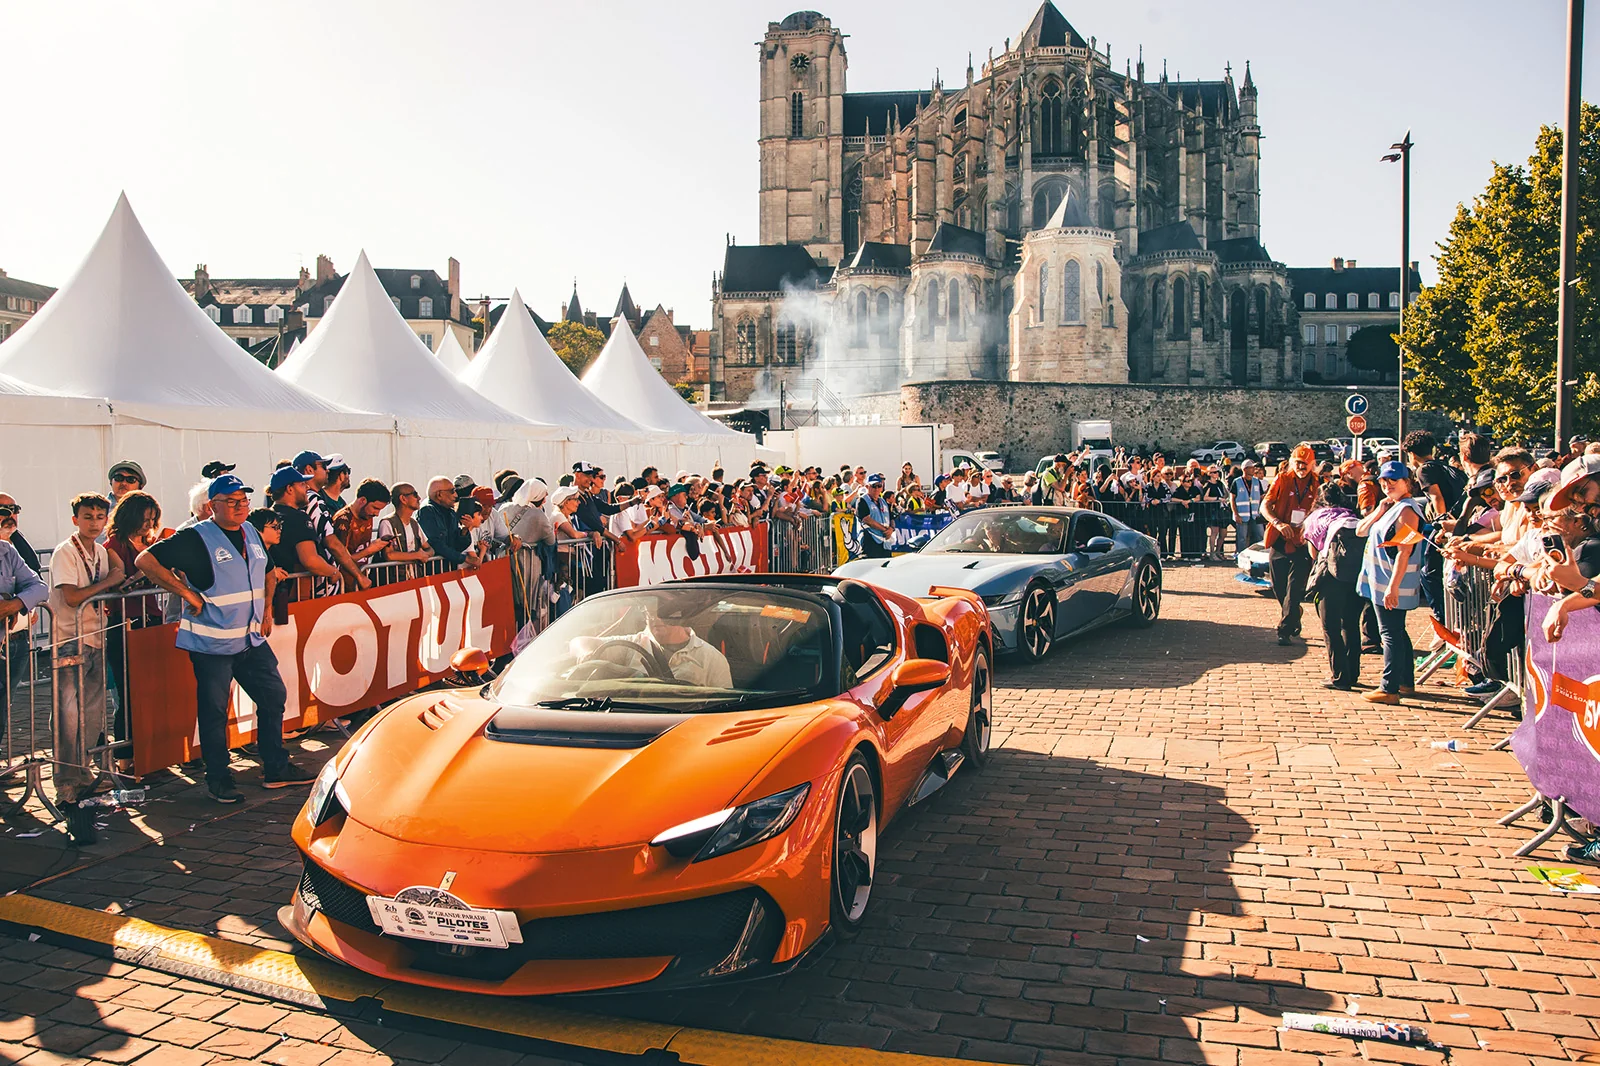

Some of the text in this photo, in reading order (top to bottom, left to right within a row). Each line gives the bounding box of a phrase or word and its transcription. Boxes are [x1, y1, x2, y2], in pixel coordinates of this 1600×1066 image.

[1350, 421, 1365, 429] STOP
[638, 530, 756, 586] MOTUL
[435, 911, 461, 919] GRANDE
[437, 917, 489, 929] PILOTES
[1332, 1026, 1378, 1039] CONFETTIS
